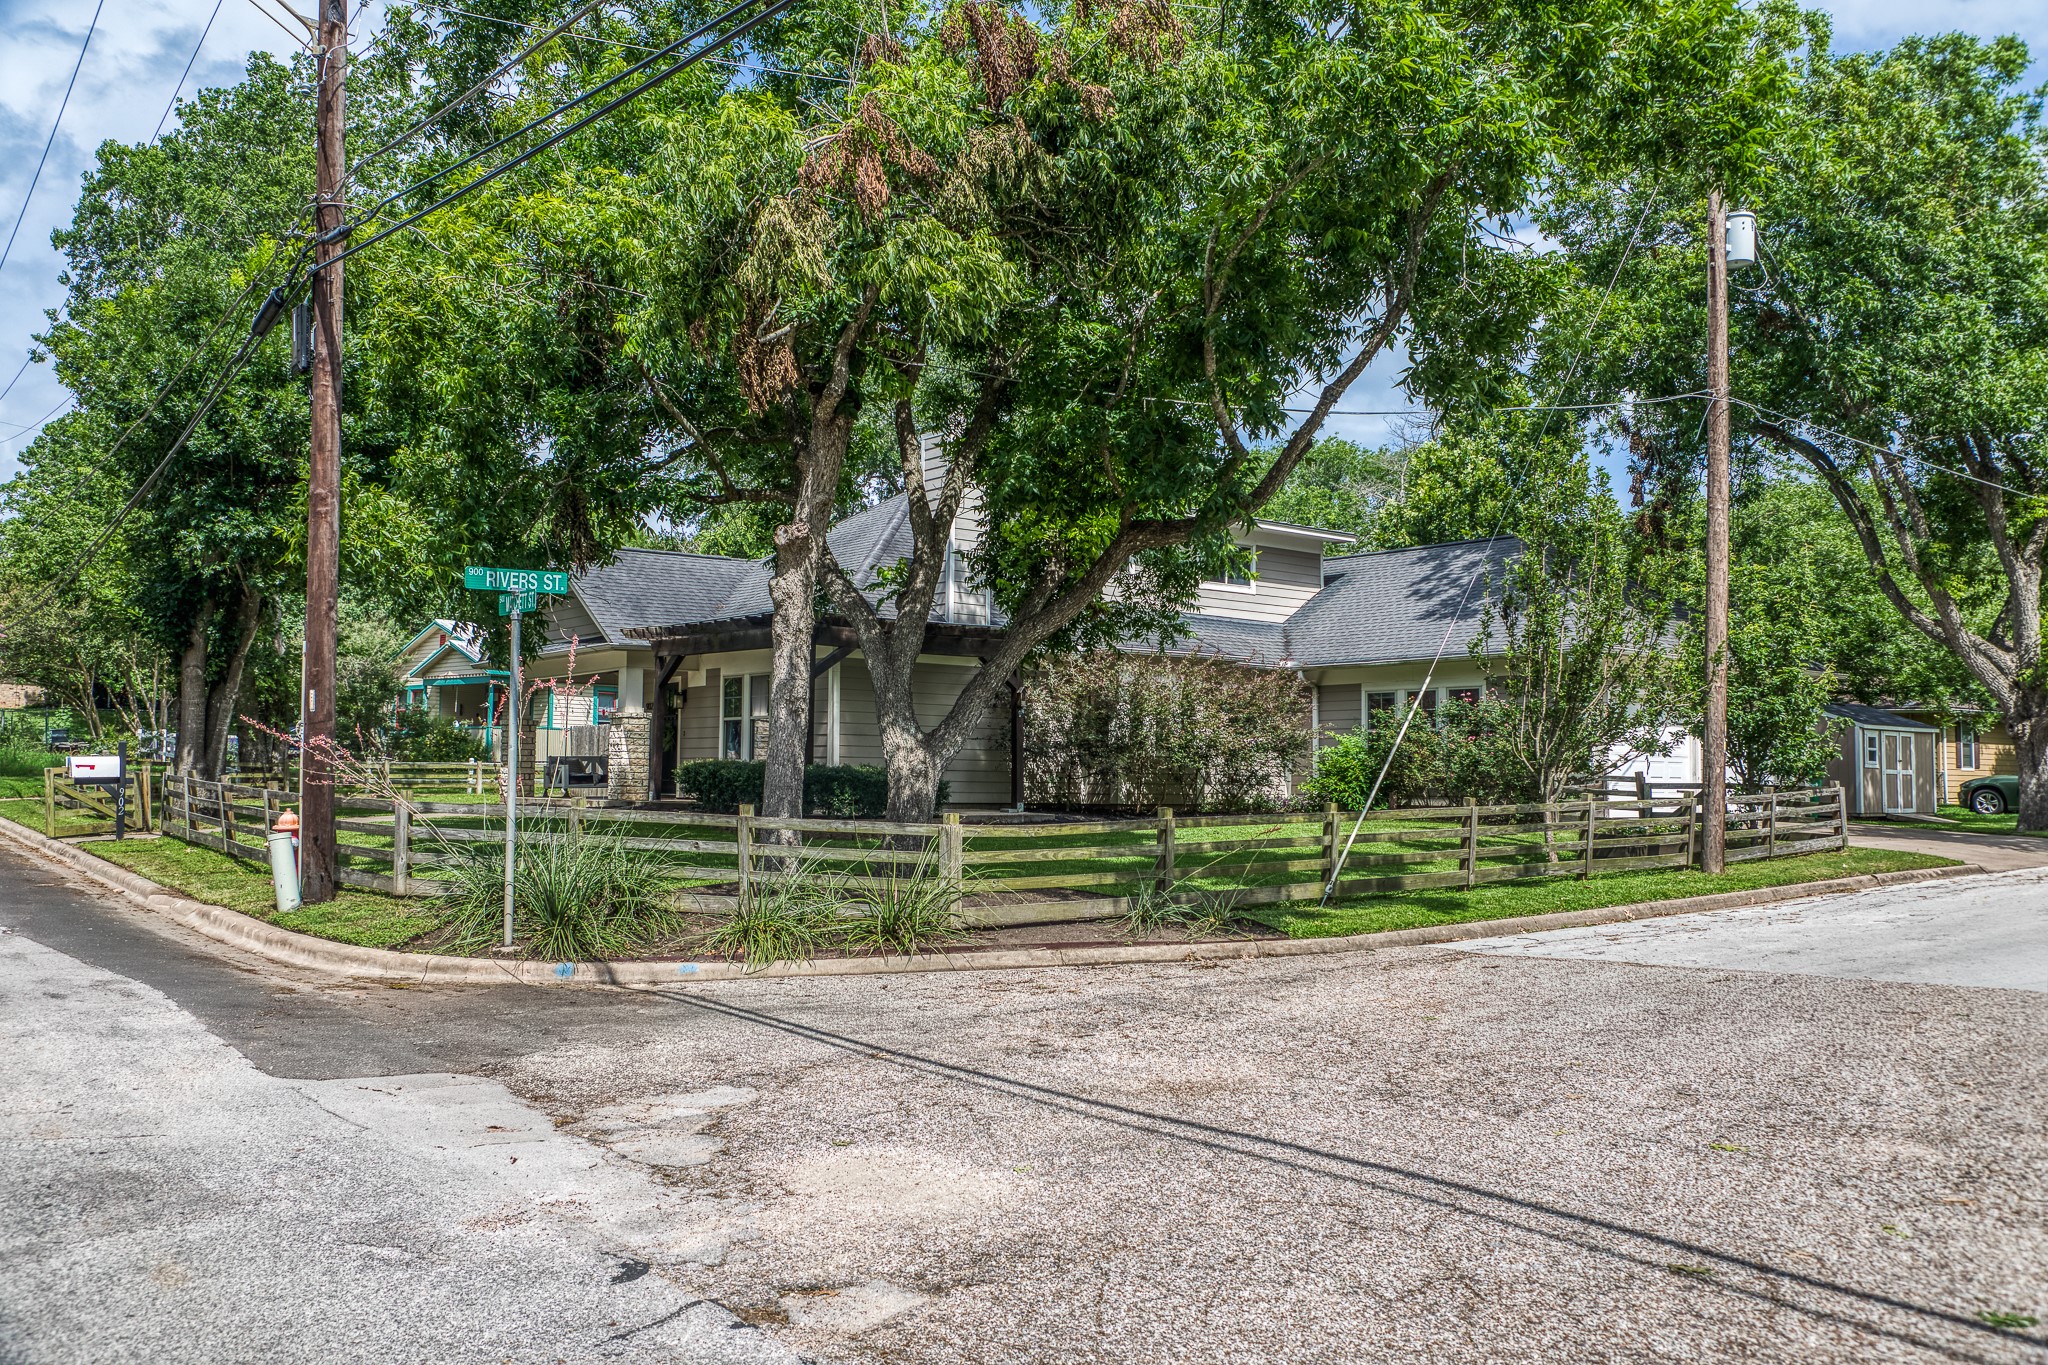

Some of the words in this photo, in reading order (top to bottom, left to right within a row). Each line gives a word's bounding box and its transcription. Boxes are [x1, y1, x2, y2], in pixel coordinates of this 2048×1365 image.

[468, 567, 484, 576] 900
[486, 571, 538, 590] RIVERS
[543, 573, 565, 591] ST.
